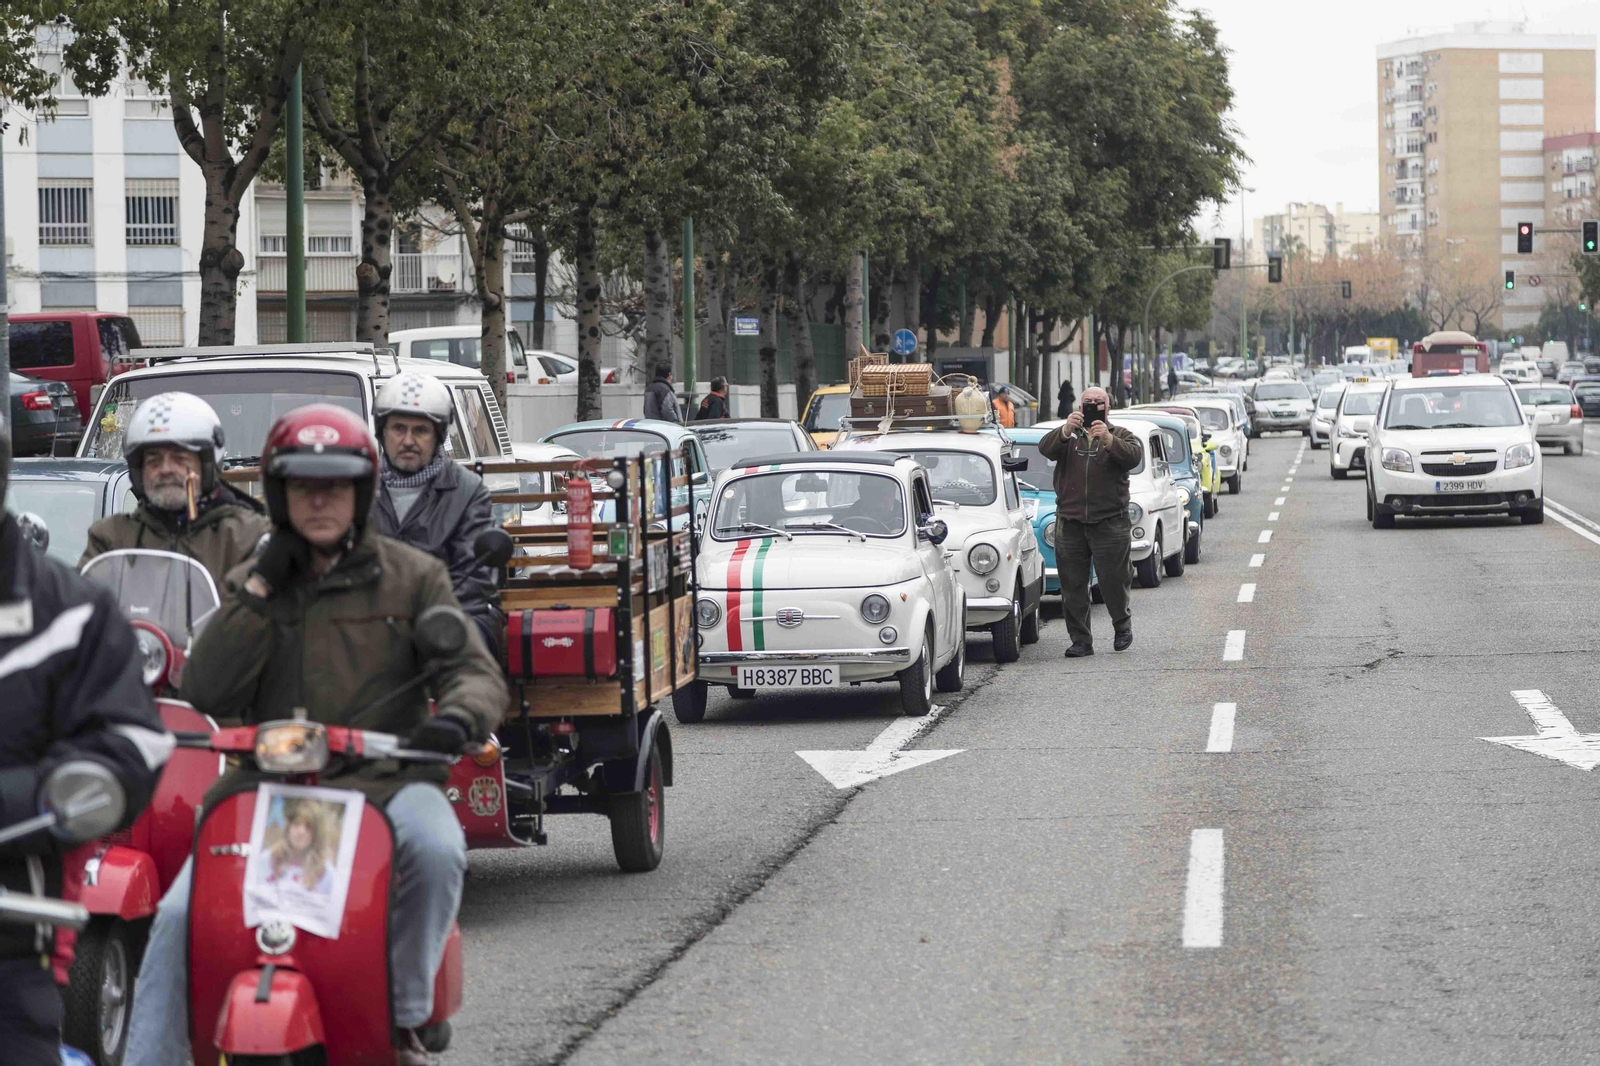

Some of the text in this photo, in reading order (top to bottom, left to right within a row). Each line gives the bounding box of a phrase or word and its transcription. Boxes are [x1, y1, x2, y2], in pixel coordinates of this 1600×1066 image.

[1443, 480, 1483, 491] 2399 HDV
[743, 668, 833, 686] H8387 BBC
